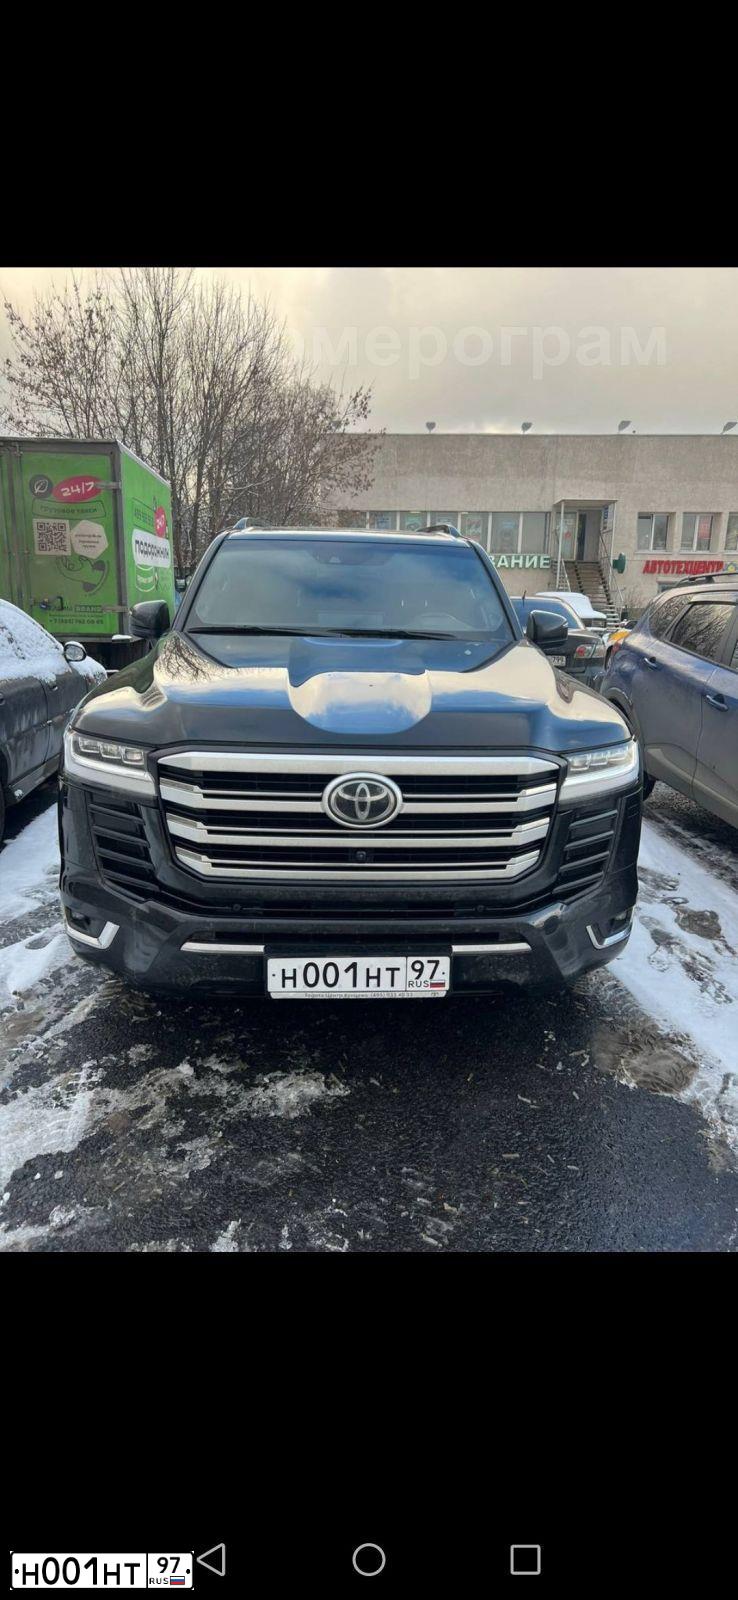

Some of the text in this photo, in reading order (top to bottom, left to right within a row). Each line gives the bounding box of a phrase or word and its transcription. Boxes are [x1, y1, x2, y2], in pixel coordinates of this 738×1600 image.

[60, 481, 95, 497] 24/7
[281, 959, 440, 989] Н001НТ 97
[408, 980, 429, 988] RUS
